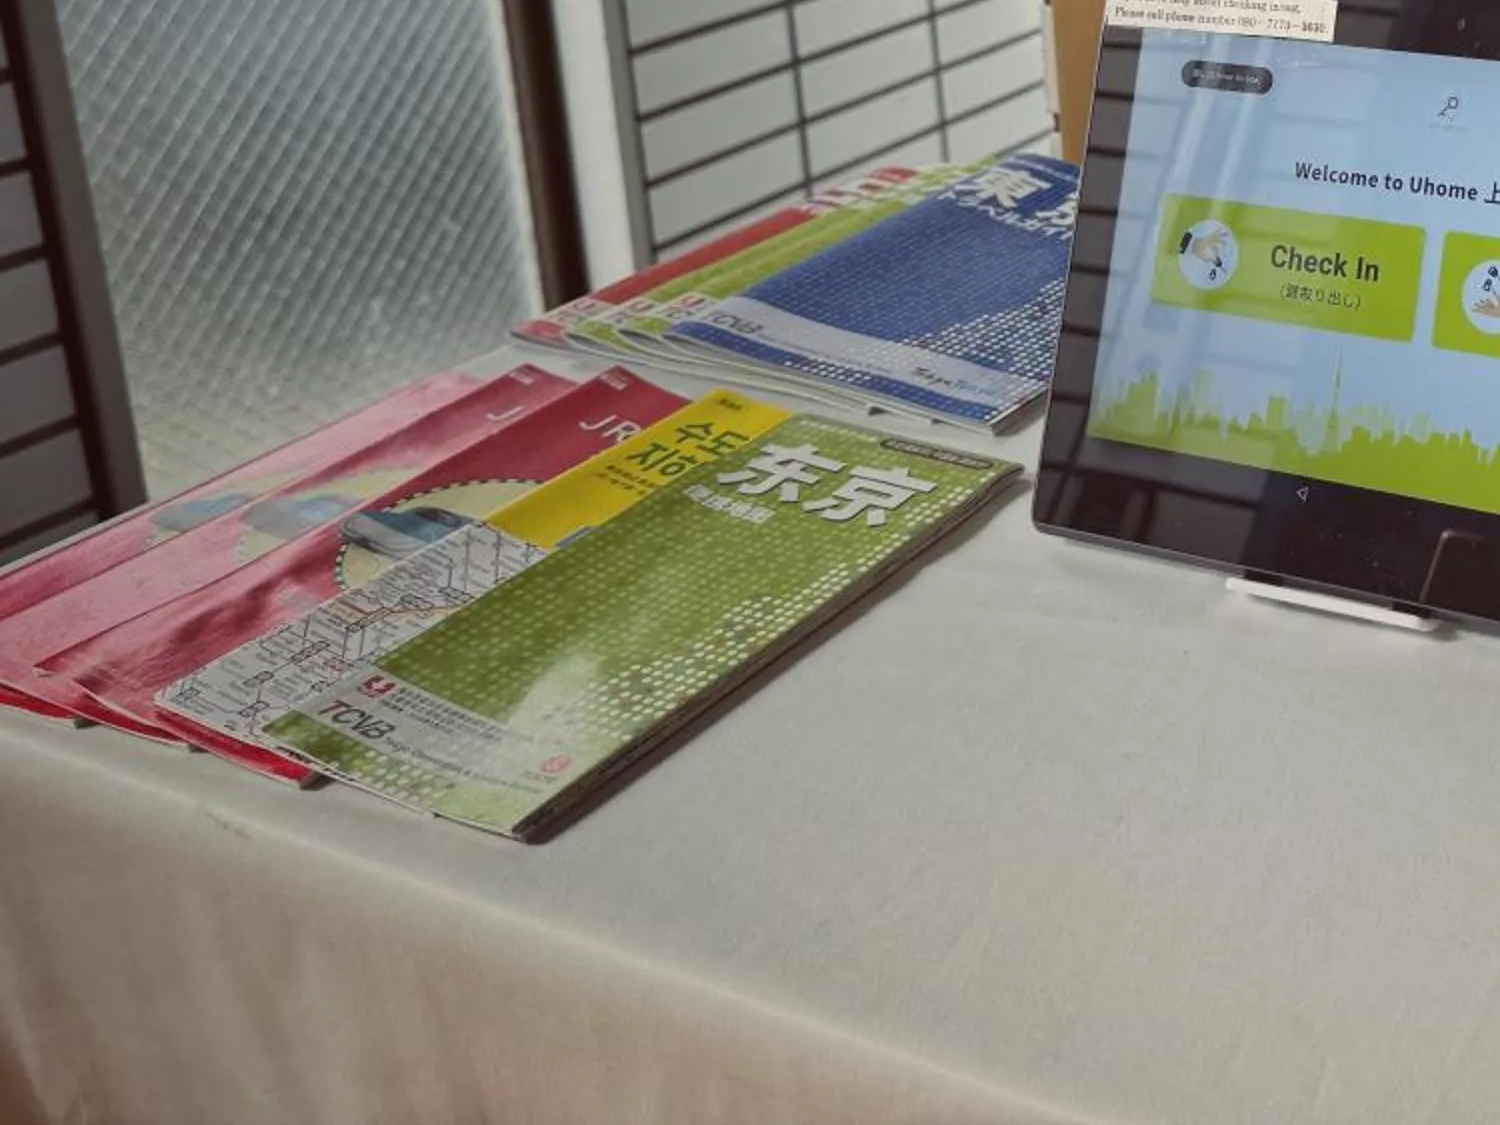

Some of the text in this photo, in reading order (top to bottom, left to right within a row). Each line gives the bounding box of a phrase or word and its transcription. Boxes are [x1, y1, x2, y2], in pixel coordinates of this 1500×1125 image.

[1115, 6, 1145, 19] Please
[1146, 8, 1165, 21] call
[1166, 10, 1195, 24] phone
[1295, 161, 1380, 190] Welcome
[1384, 172, 1403, 192] to
[1409, 176, 1479, 203] Uhome
[1270, 244, 1381, 283] Check In
[716, 442, 938, 527] 东京
[318, 698, 396, 740] TCVB
